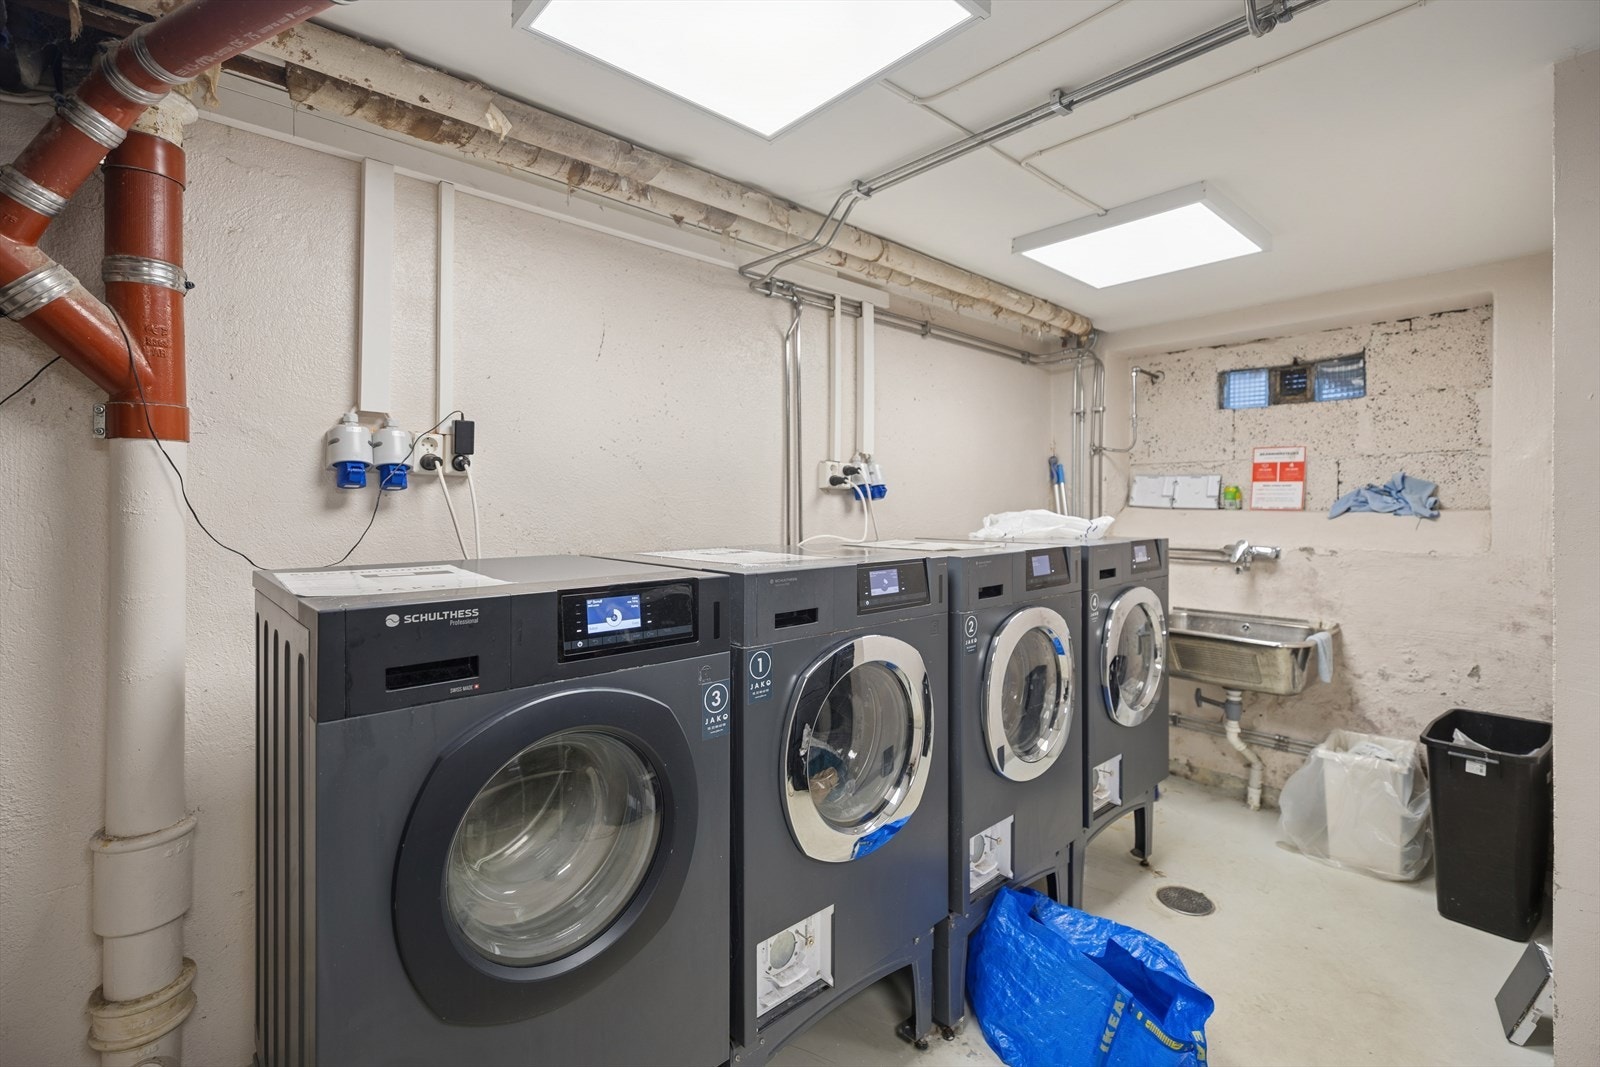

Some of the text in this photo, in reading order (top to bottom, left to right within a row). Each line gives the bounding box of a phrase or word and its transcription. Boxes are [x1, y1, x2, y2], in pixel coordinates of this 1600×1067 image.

[403, 608, 479, 624] SCHULTHESS
[449, 617, 479, 627] Professional
[968, 620, 974, 633] 2
[757, 657, 762, 673] 1
[450, 684, 473, 694] SWISS MADE
[750, 679, 771, 690] JAKO
[711, 690, 721, 707] 3
[705, 713, 729, 725] JAKO
